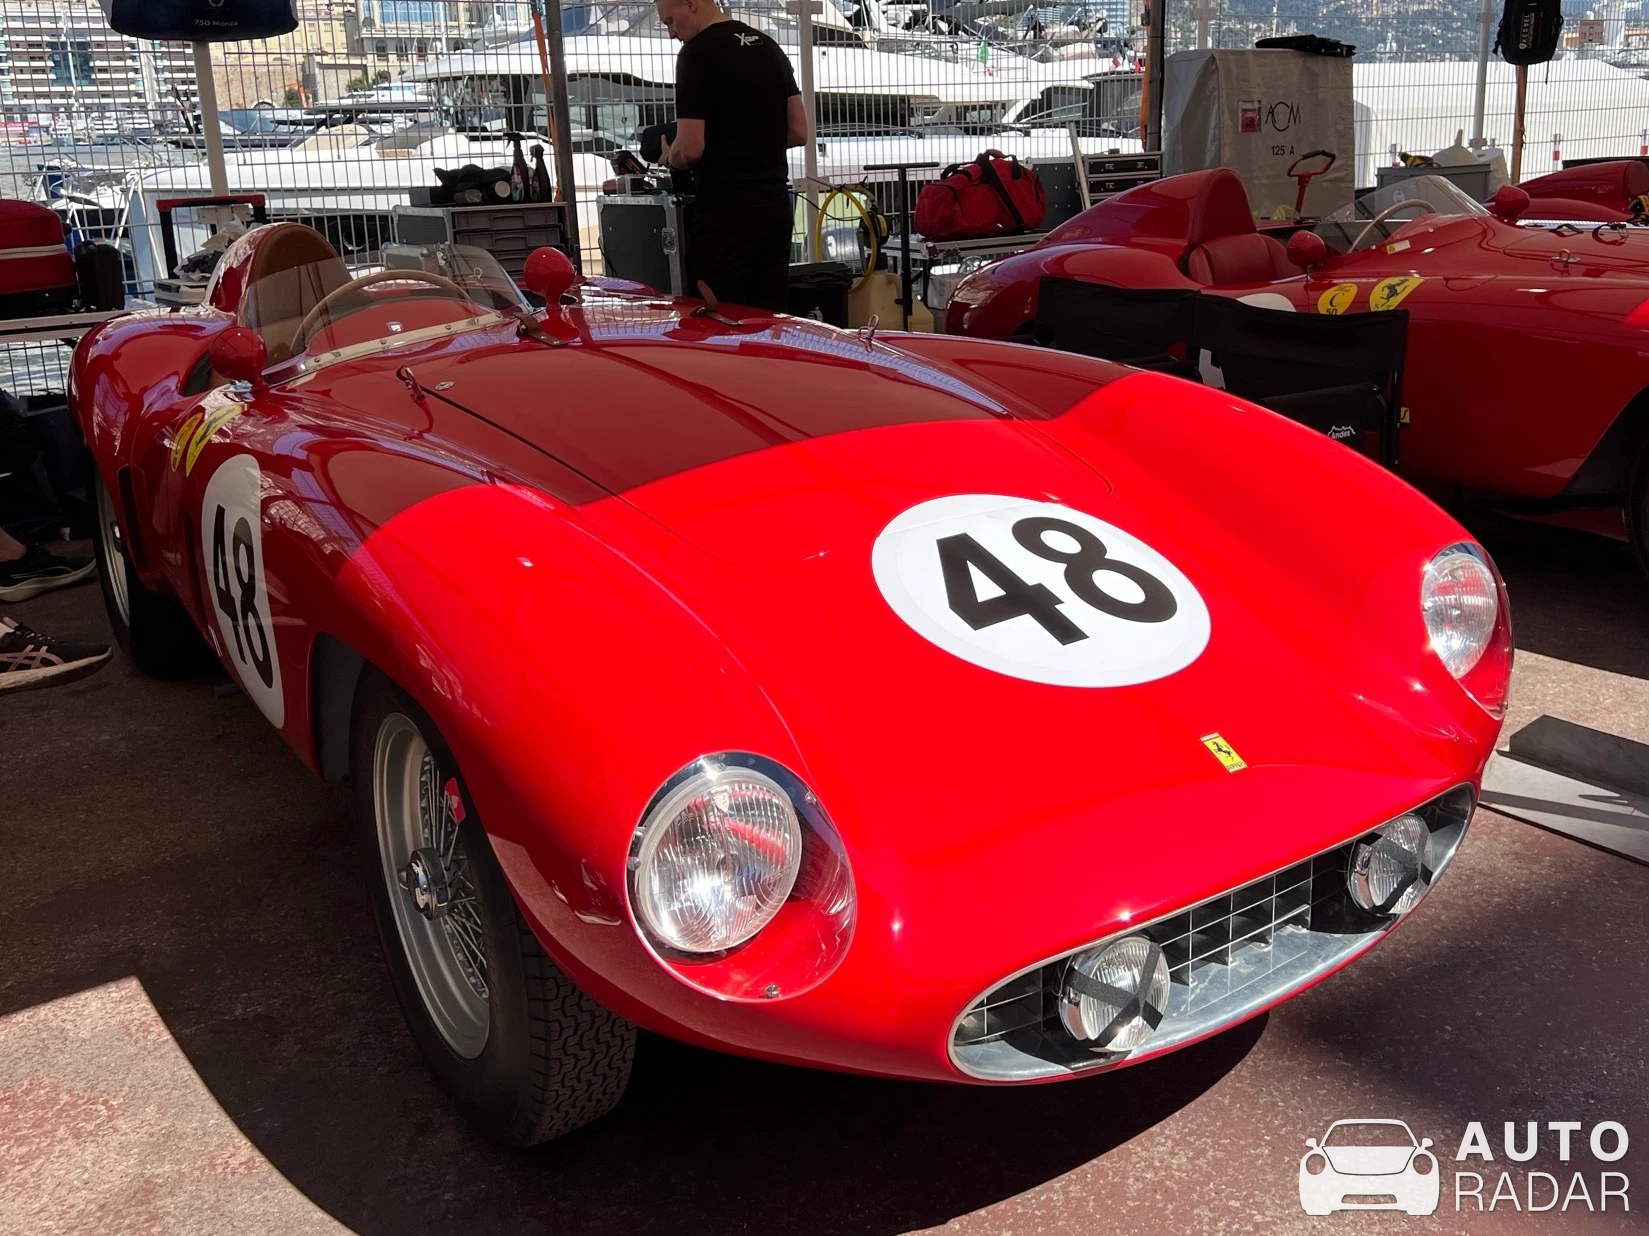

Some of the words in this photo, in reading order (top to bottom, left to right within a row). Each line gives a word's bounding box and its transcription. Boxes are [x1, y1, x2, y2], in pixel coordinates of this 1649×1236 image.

[1521, 14, 1530, 43] KESSEL
[1265, 101, 1301, 132] ACM
[1271, 145, 1286, 156] 125
[1289, 145, 1295, 156] A
[1331, 430, 1351, 440] Andes
[213, 503, 274, 689] 48
[936, 516, 1178, 646] 48
